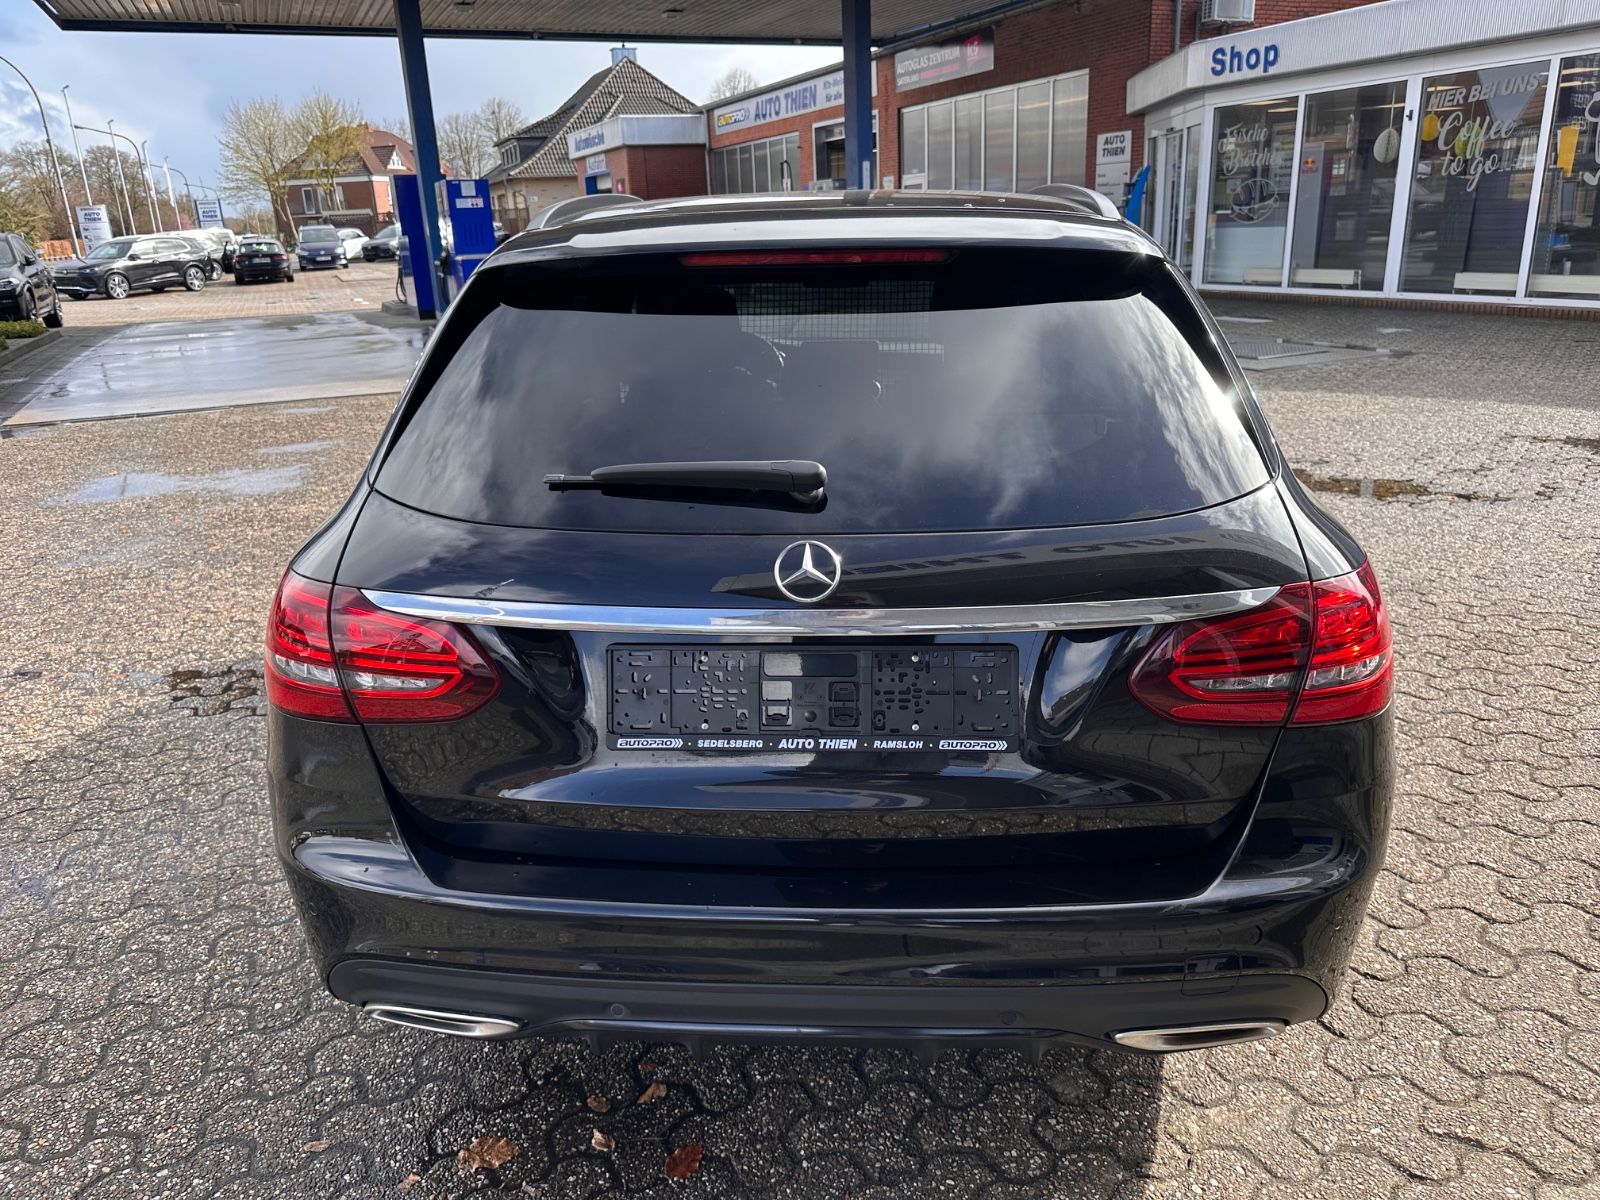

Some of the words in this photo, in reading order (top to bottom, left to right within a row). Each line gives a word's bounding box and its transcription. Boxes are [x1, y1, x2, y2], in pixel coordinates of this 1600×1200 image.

[896, 54, 929, 74] AUTOGLAS
[929, 45, 961, 66] ZENTRUM
[1211, 44, 1278, 76] Shop
[754, 95, 781, 122] AUTO
[784, 84, 817, 115] THIEN
[1427, 87, 1466, 109] HIER
[1468, 81, 1497, 103] BEI
[1502, 73, 1541, 96] UNS
[1103, 134, 1125, 146] AUTO
[1219, 122, 1268, 146] Frische
[1437, 111, 1517, 159] Coffee
[1102, 146, 1126, 157] THIEN
[1439, 151, 1465, 177] to
[1467, 154, 1500, 192] go
[696, 739, 764, 748] SEDELSBERG
[778, 738, 815, 749] AUTO
[818, 738, 858, 749] THIEN
[873, 740, 924, 749] RAMSLOH
